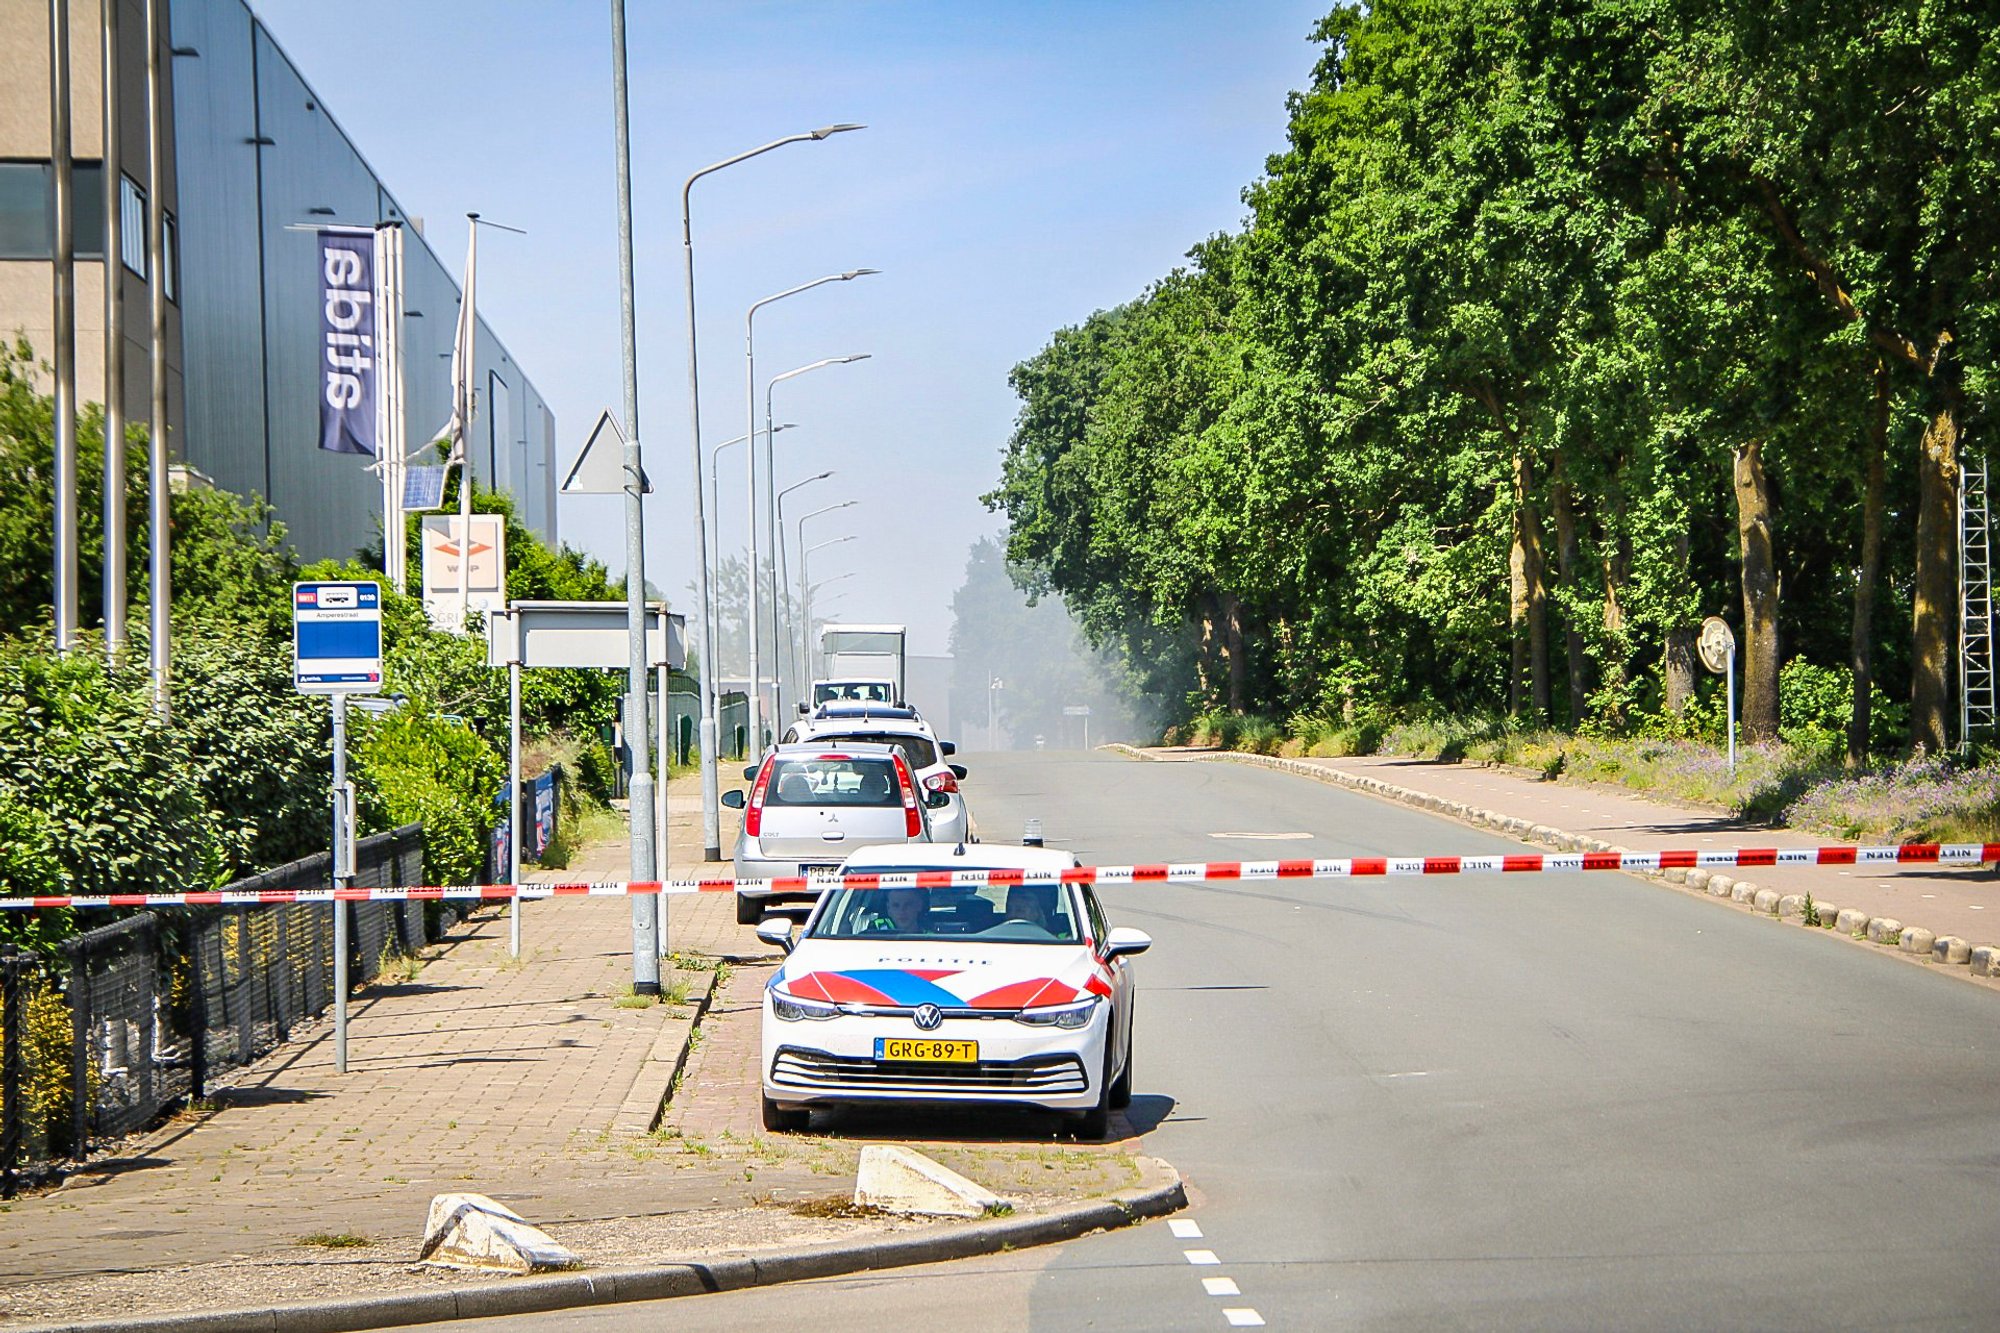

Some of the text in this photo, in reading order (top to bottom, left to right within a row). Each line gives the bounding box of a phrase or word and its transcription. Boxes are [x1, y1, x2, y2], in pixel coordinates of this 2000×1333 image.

[446, 565, 480, 573] WP
[878, 957, 992, 965] POLITIE
[890, 1042, 972, 1058] GRG-89-T
